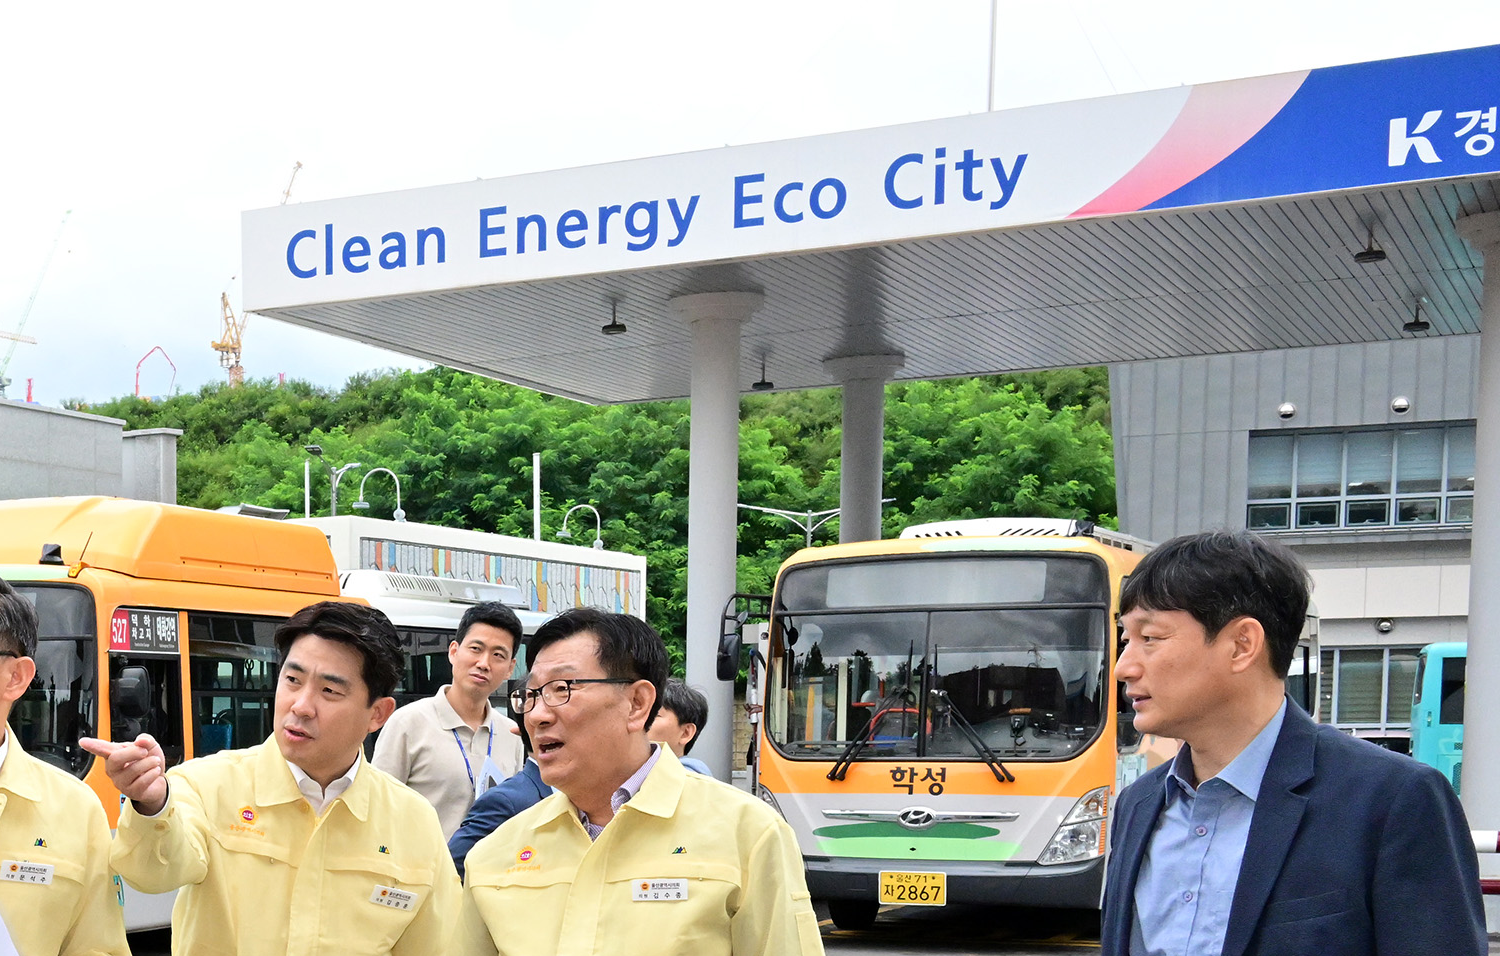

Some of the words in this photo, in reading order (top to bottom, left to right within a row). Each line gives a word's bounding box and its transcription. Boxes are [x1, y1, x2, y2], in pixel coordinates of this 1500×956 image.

[1388, 110, 1443, 167] K
[1454, 106, 1498, 157] 경
[286, 224, 446, 279] Clean
[479, 196, 701, 258] Energy
[734, 173, 847, 228] Eco
[884, 147, 1029, 210] City
[111, 617, 128, 644] 527
[889, 766, 947, 796] 학성
[896, 874, 912, 883] 울산
[914, 875, 928, 883] 71
